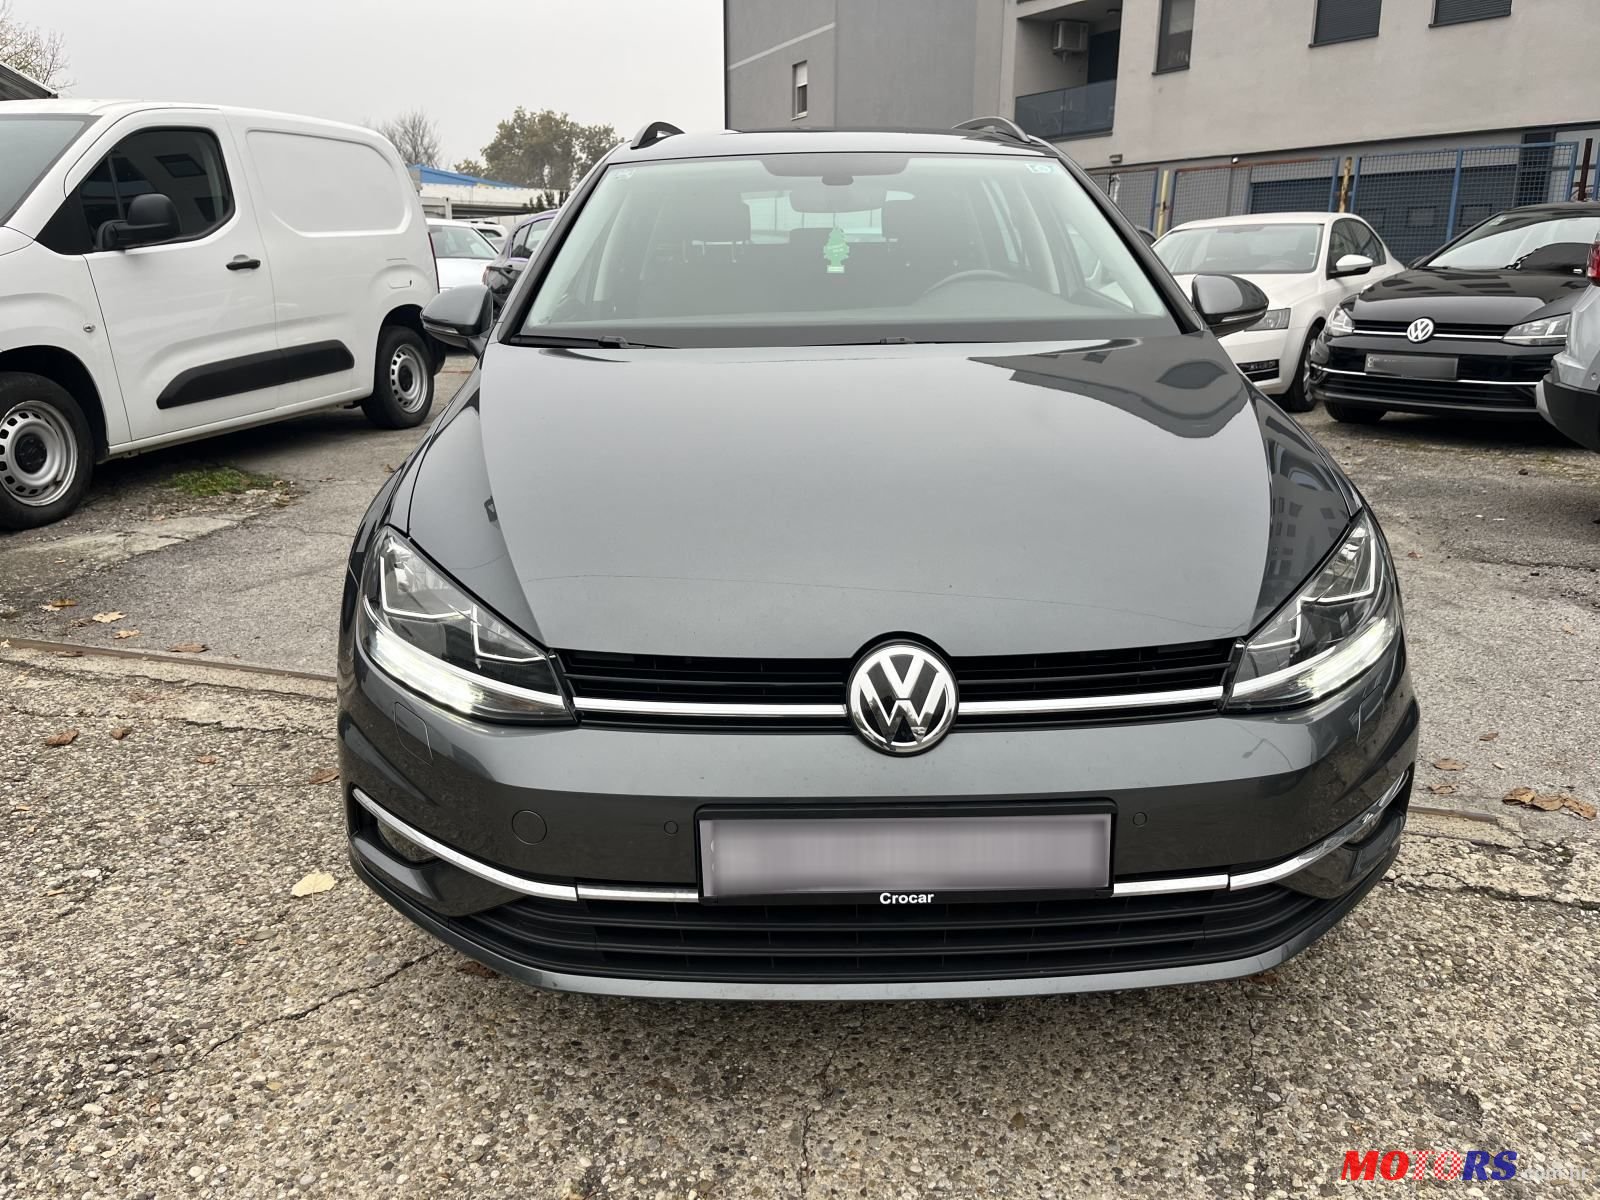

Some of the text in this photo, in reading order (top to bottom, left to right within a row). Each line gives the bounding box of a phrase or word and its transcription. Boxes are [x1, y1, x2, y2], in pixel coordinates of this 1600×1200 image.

[1407, 318, 1434, 342] VW
[851, 645, 955, 752] VW
[879, 892, 935, 905] Crocar
